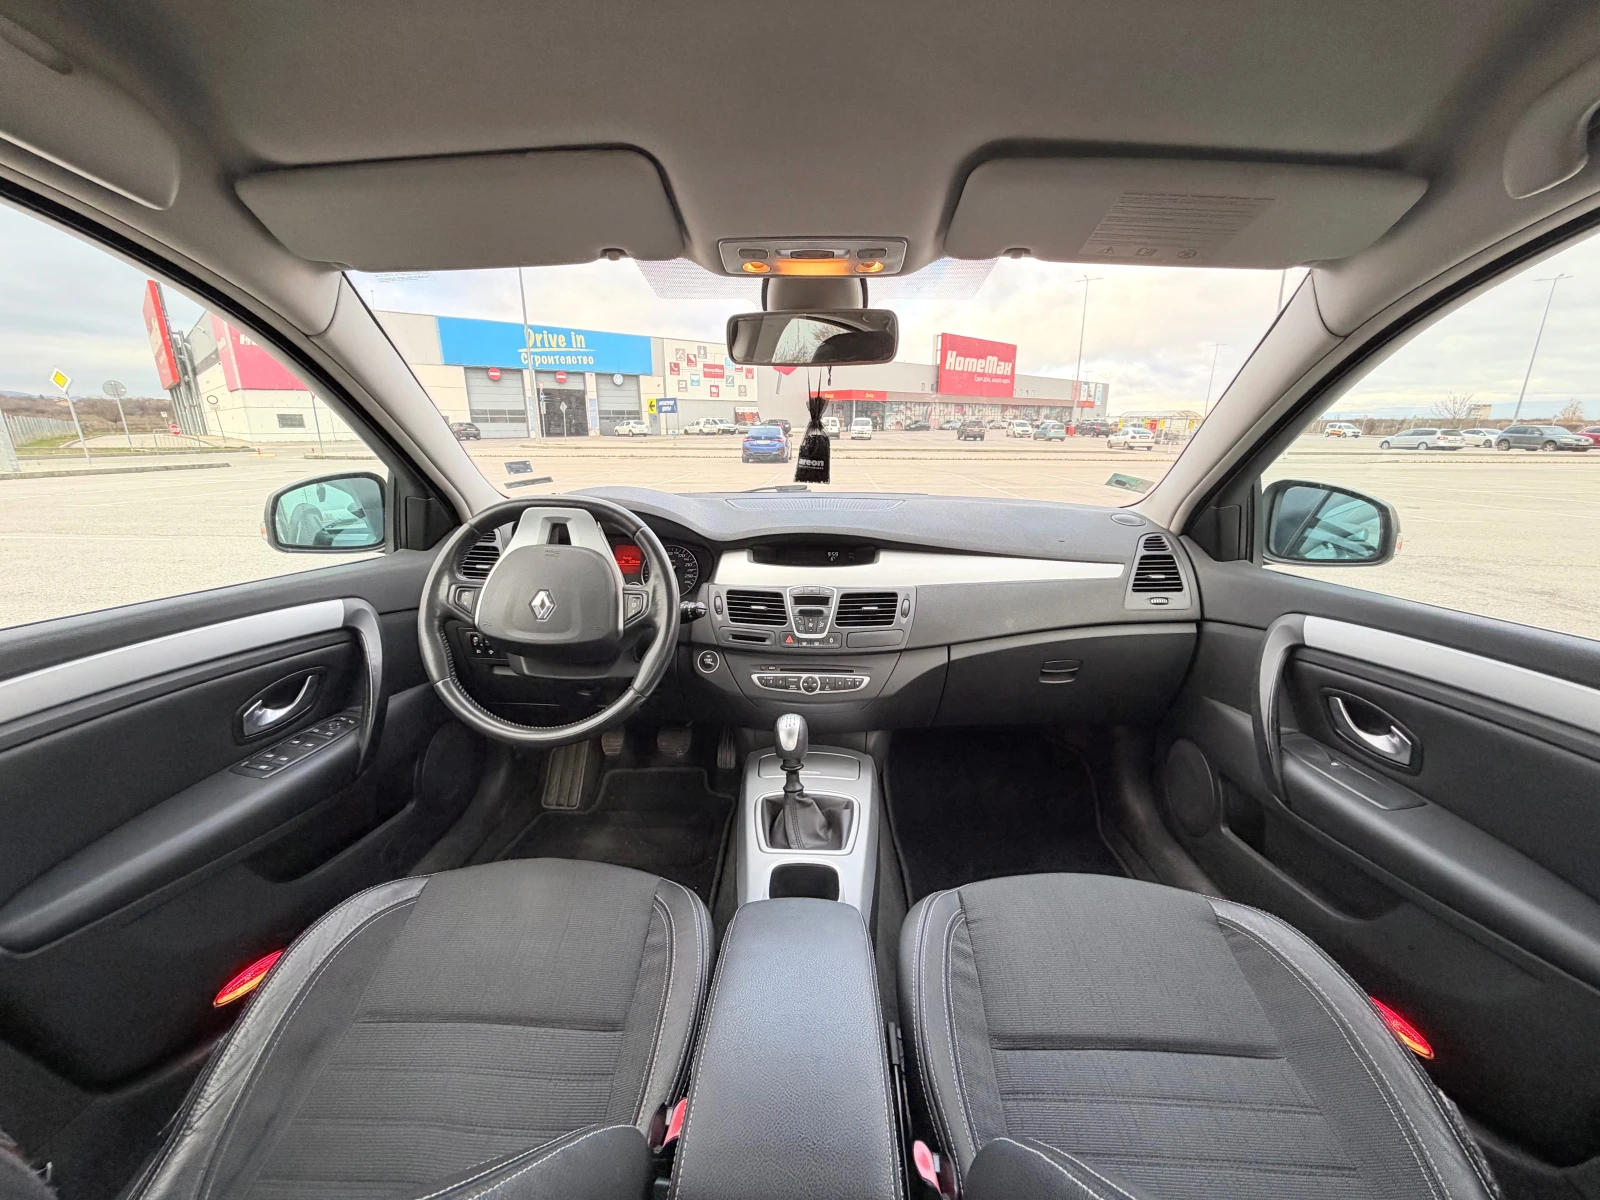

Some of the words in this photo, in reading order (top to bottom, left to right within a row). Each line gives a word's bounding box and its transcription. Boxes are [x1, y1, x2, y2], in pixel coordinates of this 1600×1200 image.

[524, 328, 567, 348] Drive
[571, 331, 586, 348] in
[945, 350, 1012, 376] HomeMax
[798, 458, 825, 467] areon
